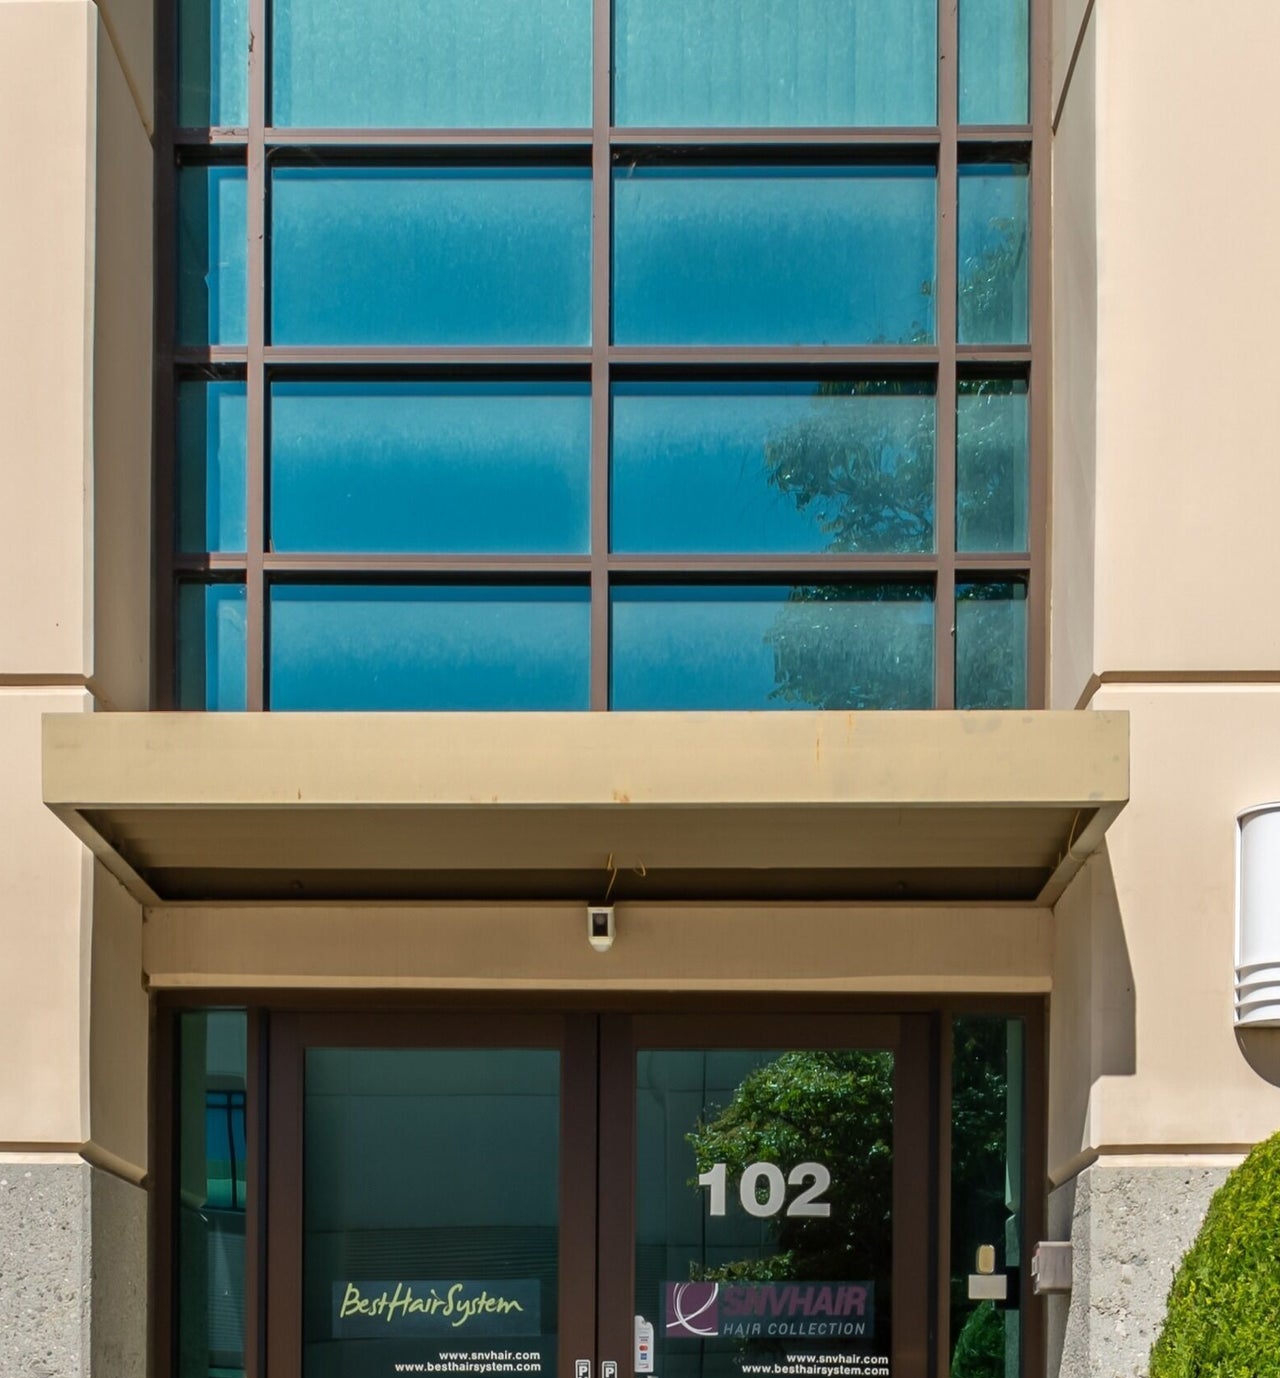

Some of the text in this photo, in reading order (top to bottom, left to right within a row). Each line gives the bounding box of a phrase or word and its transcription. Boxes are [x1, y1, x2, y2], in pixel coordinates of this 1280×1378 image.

[698, 1162, 831, 1217] 102
[722, 1285, 868, 1317] SNVHAIR
[723, 1322, 866, 1336] HAIR COLLECTION
[439, 1350, 541, 1361] www.snvhair.com
[786, 1353, 889, 1365] www.snvhair.com
[394, 1361, 542, 1374] www.besthairsystem.com
[741, 1364, 890, 1377] www.besthairsystem.com
